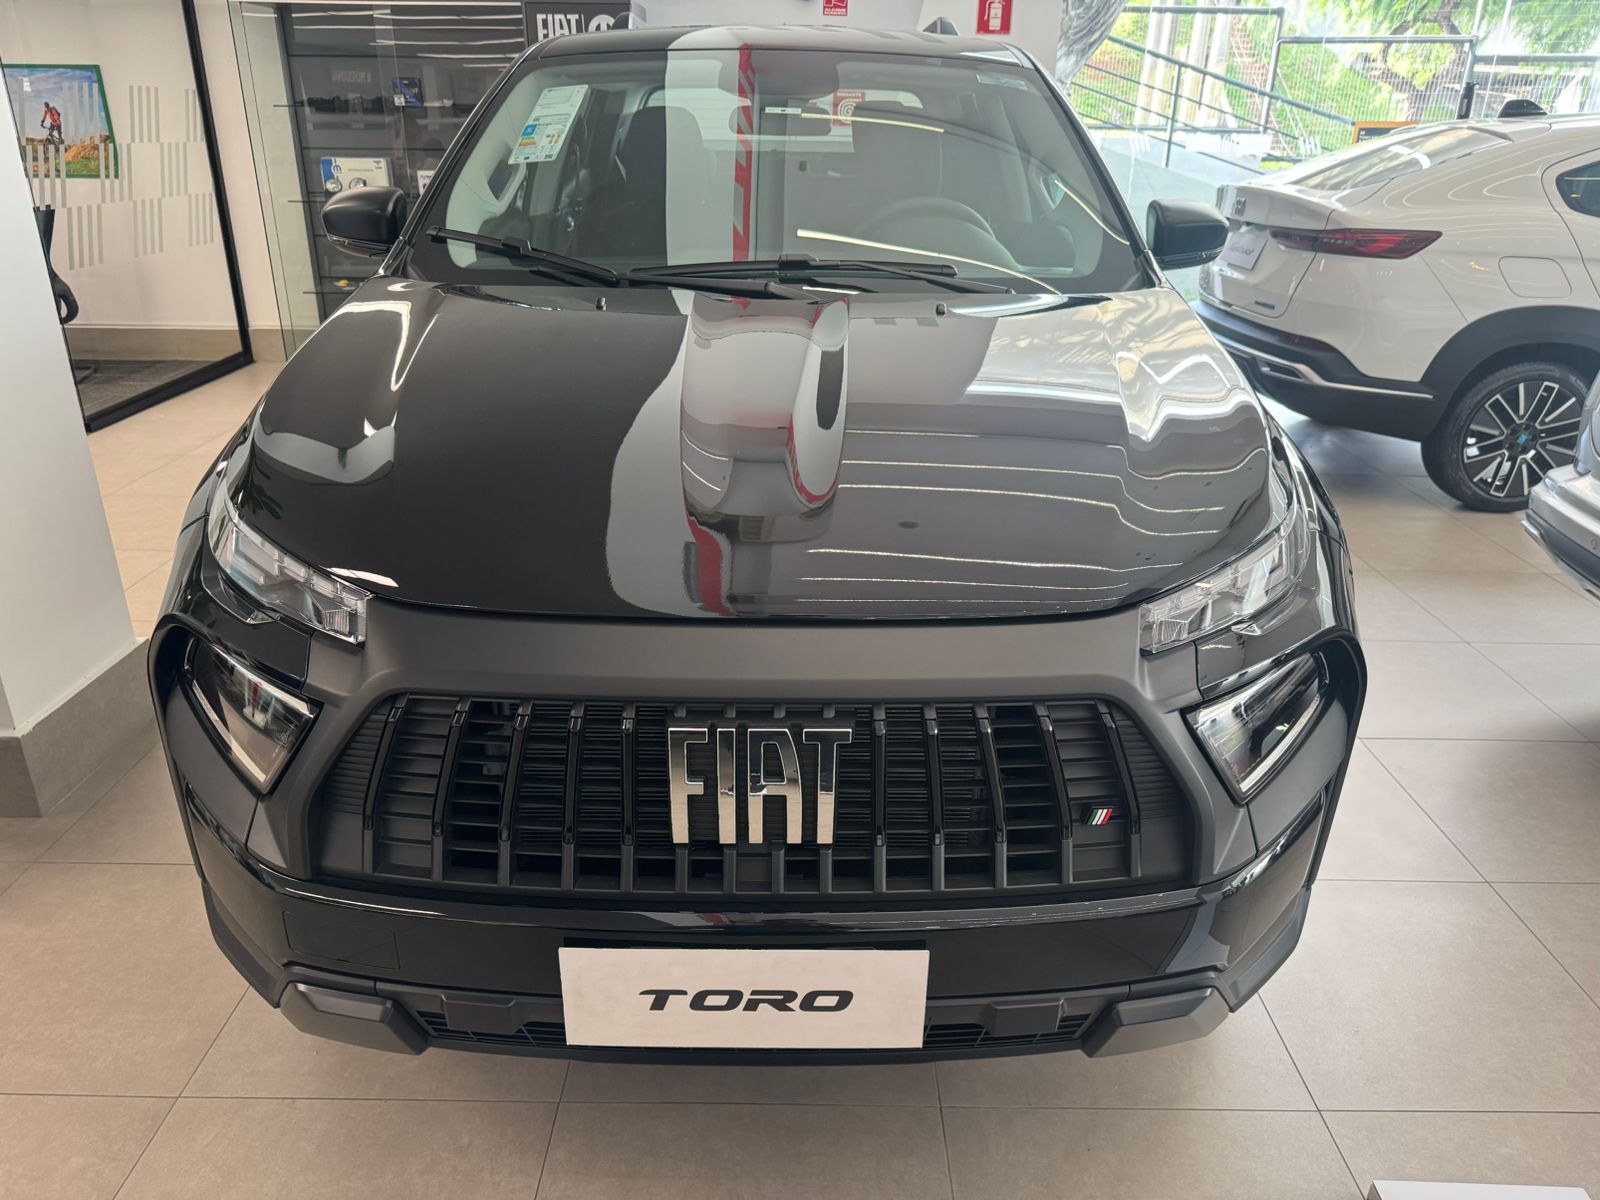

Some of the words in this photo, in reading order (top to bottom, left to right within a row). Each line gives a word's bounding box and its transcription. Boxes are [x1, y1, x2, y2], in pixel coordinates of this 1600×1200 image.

[536, 13, 580, 41] FIAT
[668, 727, 852, 844] FIAT
[638, 989, 854, 1012] TORO
